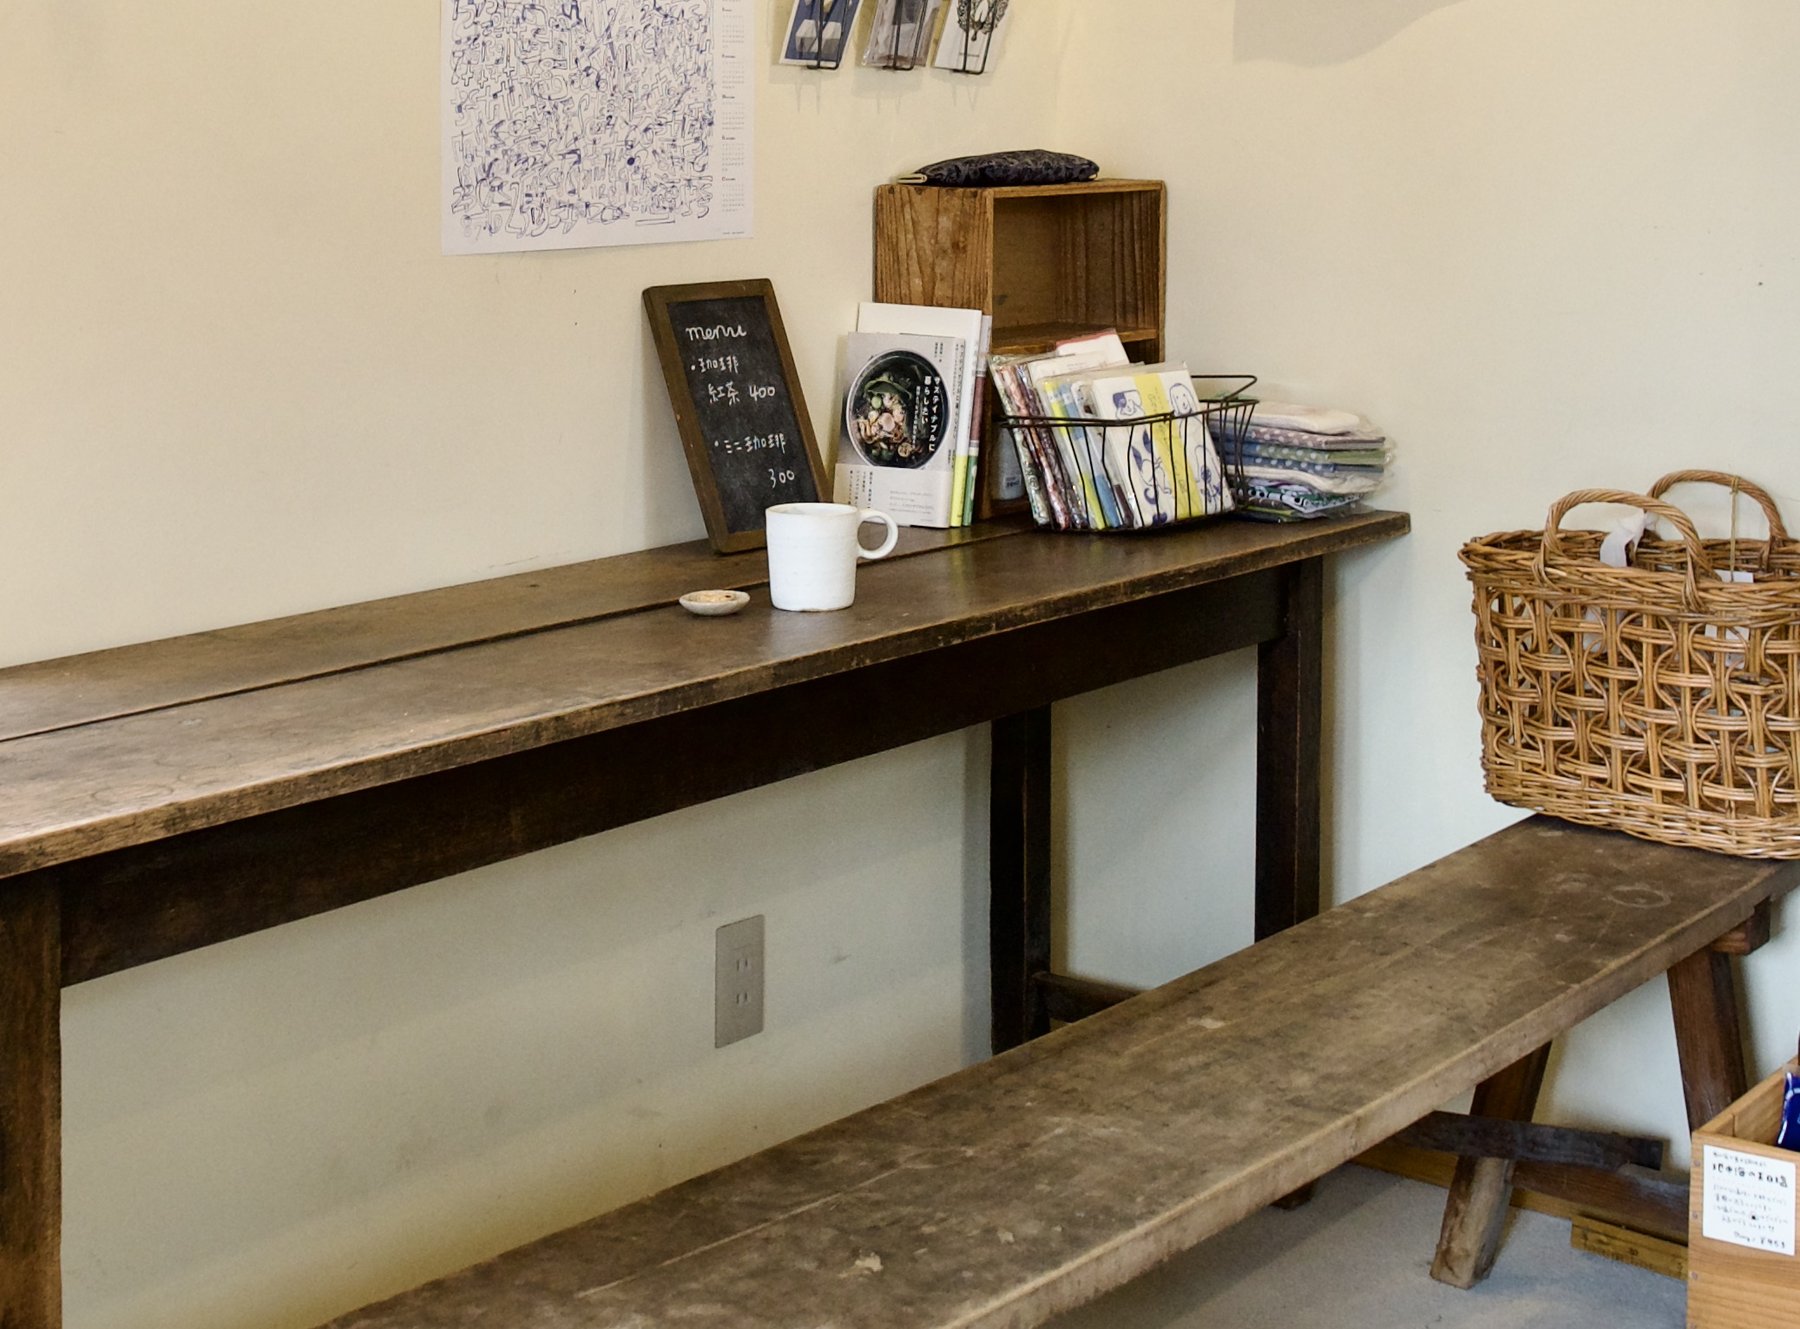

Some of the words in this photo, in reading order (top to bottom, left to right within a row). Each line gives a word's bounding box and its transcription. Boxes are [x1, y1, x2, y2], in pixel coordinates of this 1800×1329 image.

[686, 324, 747, 341] menu
[708, 381, 740, 408] 紅茶
[749, 384, 776, 402] 400
[768, 468, 795, 489] 300
